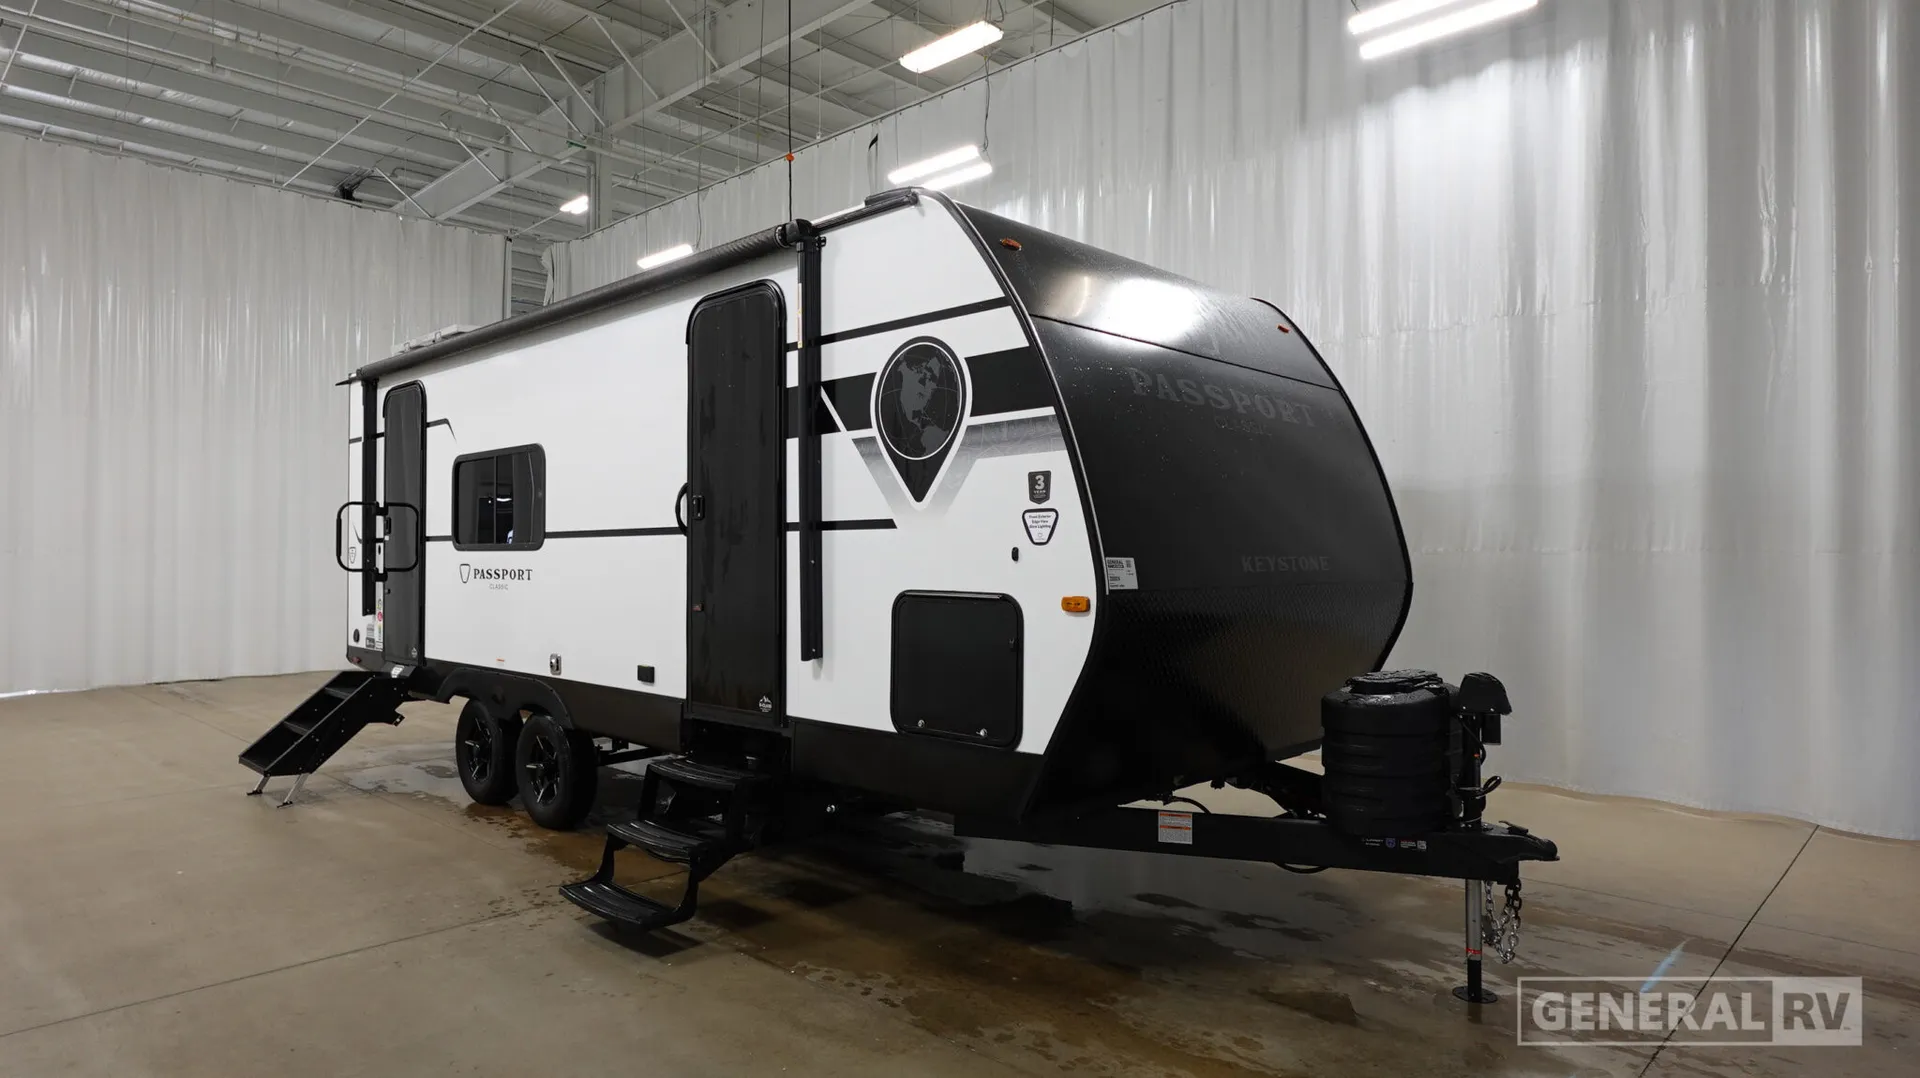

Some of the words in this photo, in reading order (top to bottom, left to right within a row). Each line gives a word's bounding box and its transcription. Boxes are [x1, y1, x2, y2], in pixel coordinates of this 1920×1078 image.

[1128, 367, 1317, 428] PASSPORT
[1034, 474, 1045, 490] 3
[1240, 555, 1331, 573] KEYSTONE
[473, 568, 533, 581] PASSPORT
